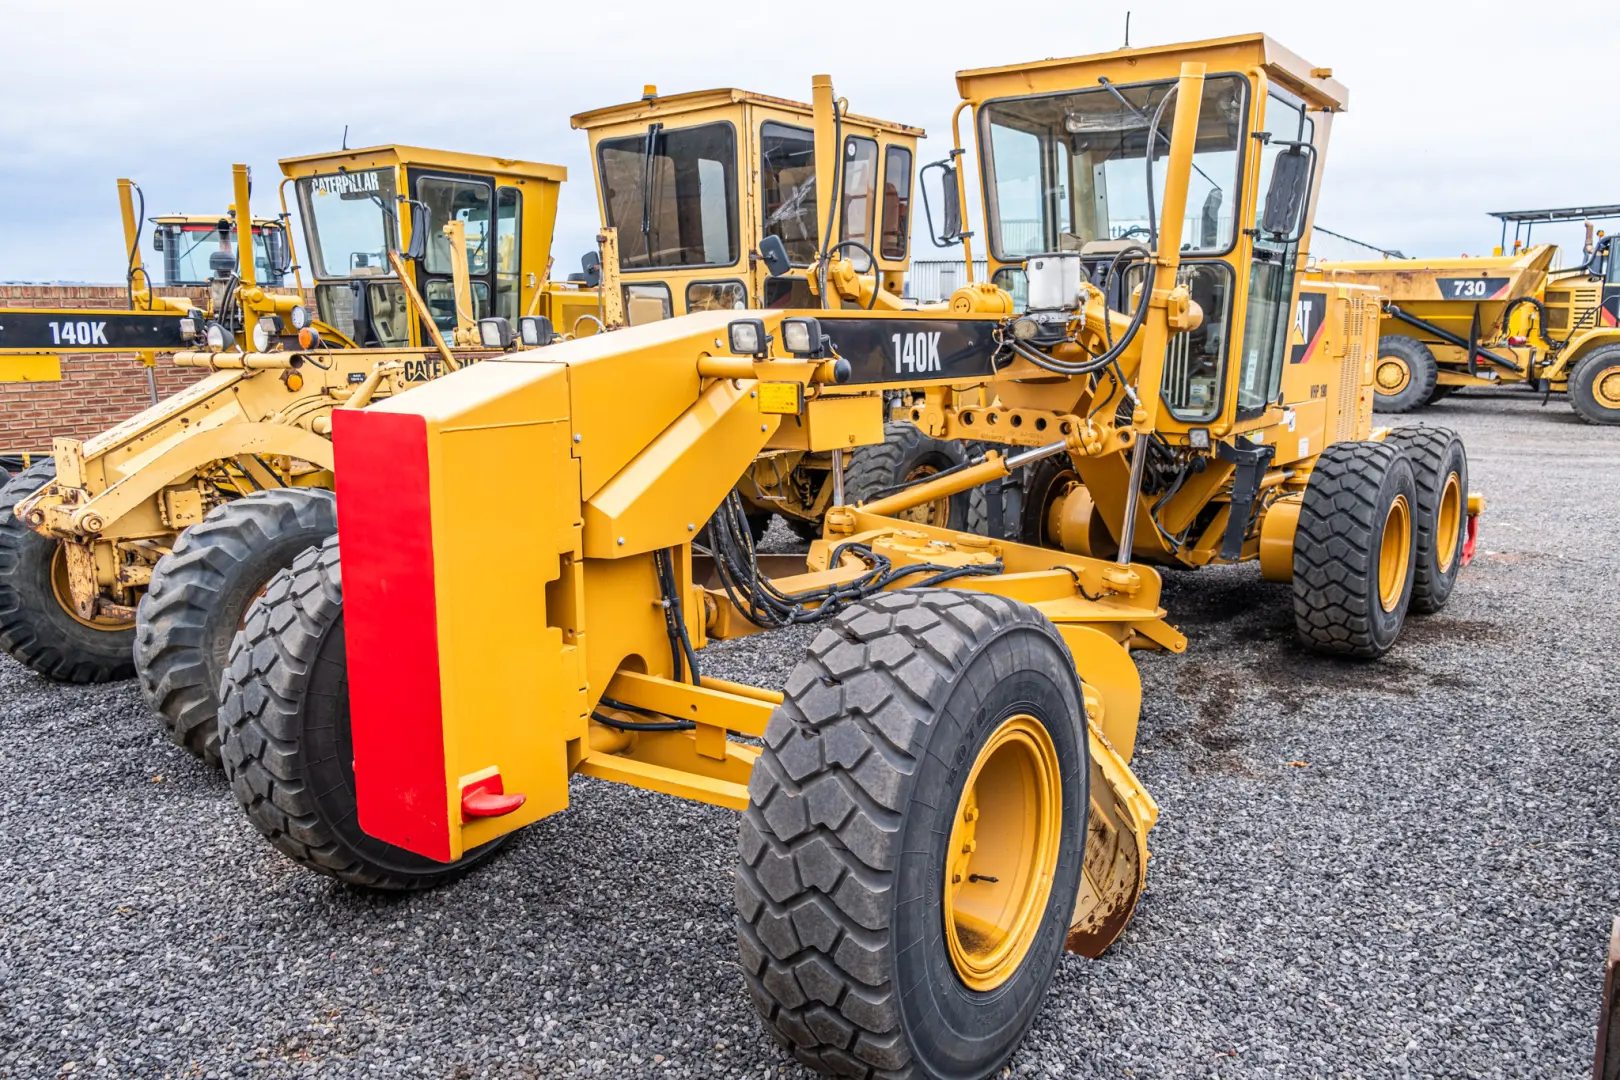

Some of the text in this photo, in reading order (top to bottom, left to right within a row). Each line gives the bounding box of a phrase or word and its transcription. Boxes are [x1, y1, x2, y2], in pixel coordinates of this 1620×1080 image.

[312, 172, 379, 194] CATERPILLAR
[1454, 280, 1486, 296] 730
[49, 321, 109, 345] 140K
[1293, 300, 1312, 345] AT
[892, 331, 942, 374] 140K
